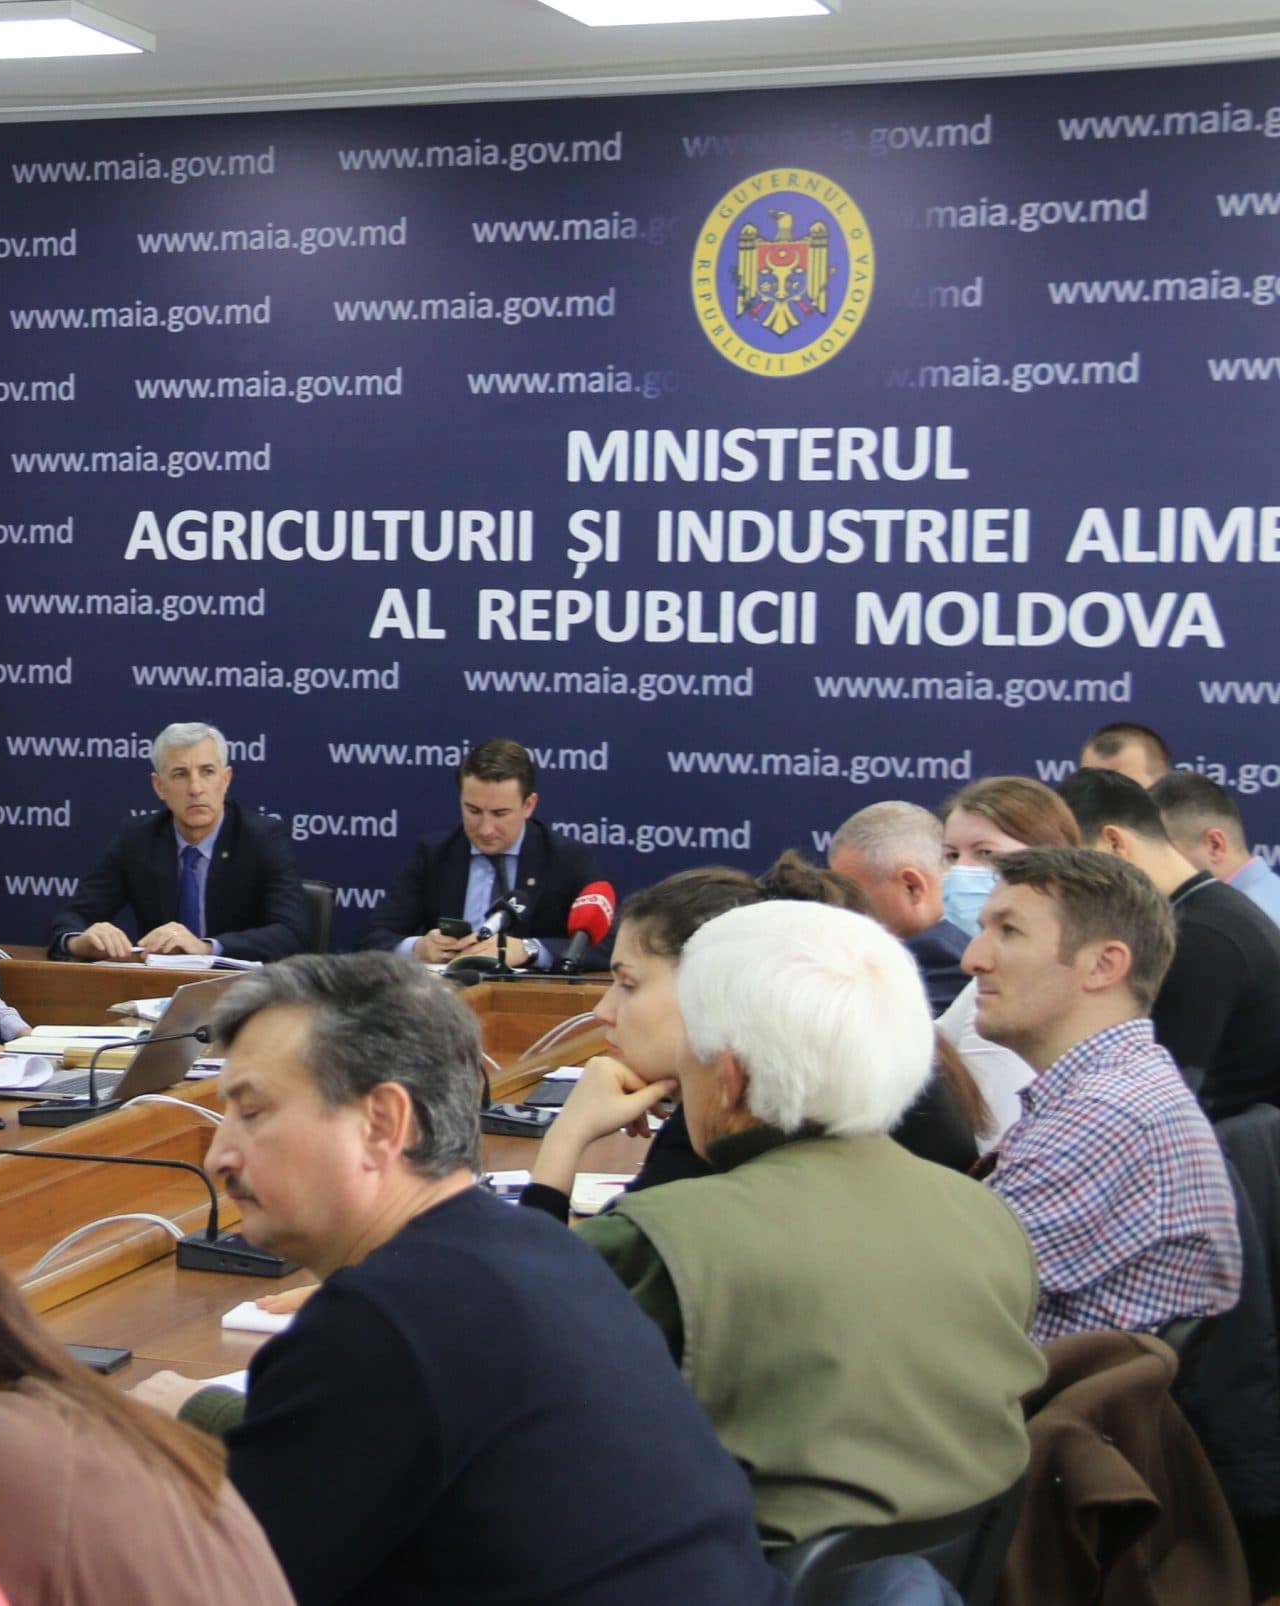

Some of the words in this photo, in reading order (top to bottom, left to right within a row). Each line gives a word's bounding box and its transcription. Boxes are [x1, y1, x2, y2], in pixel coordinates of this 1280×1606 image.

[12, 145, 275, 184] www.maia.gov.md
[338, 131, 622, 172] www.maia.gov.md
[719, 173, 849, 220] GUVERNUL
[138, 217, 406, 255] www.maia.gov.md
[1048, 270, 1280, 305] www.maia.g
[11, 296, 270, 332] www.maia.gov.md
[333, 288, 614, 325] www.maia.gov.md
[696, 258, 785, 373] REPUBLICII
[800, 252, 869, 369] MOLDOVA
[135, 367, 402, 403] www.maia.gov.md
[12, 443, 270, 477] www.maia.gov.md
[568, 426, 968, 482] MINISTERUL
[125, 510, 532, 561] AGRICULTURII
[659, 509, 1029, 563] INDUSTRIEI
[1066, 507, 1280, 562] ALIME
[6, 588, 264, 621] www.maia.gov.md
[370, 588, 446, 639] AL
[479, 589, 816, 644] REPUBLICII
[856, 591, 1224, 648] MOLDOVA
[132, 661, 399, 694] www.maia.gov.md
[464, 666, 753, 701] www.maia.gov.md
[815, 671, 1131, 708] www.maia.gov.md
[668, 748, 972, 783] www.maia.gov.md
